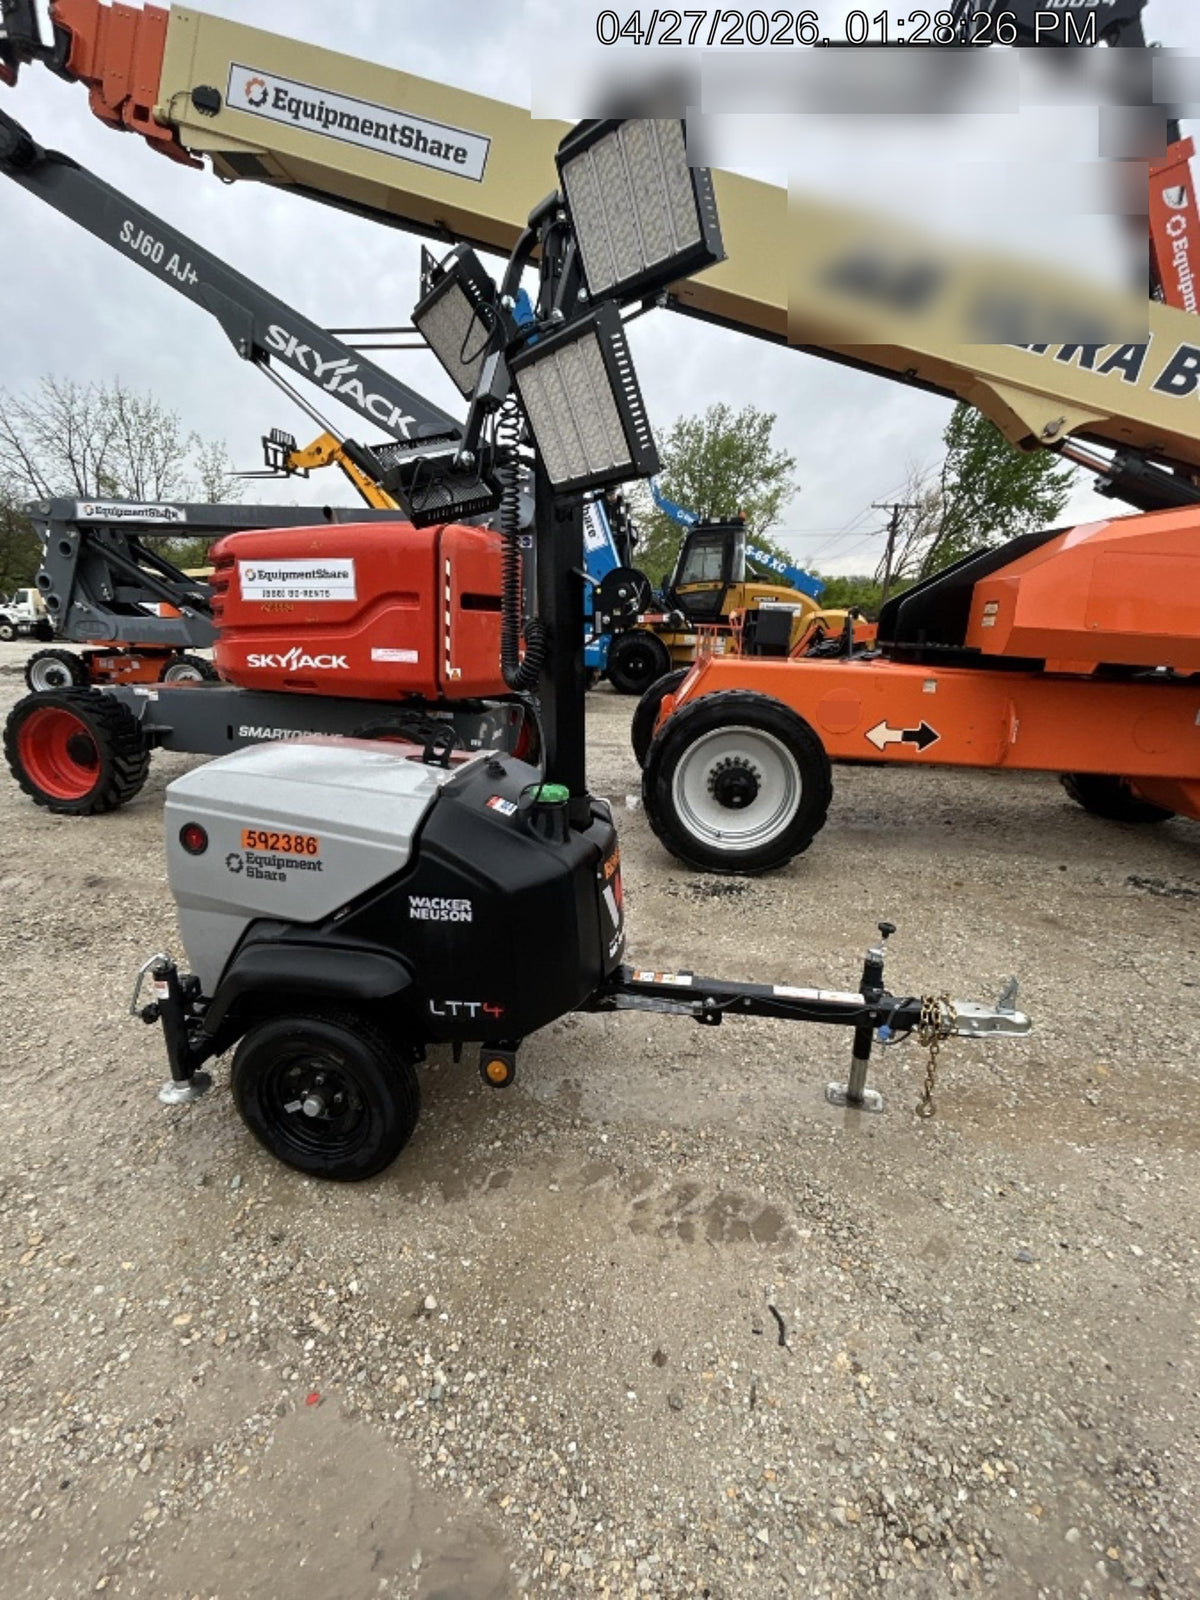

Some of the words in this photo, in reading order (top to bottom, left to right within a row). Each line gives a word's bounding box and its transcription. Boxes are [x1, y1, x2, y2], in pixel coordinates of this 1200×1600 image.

[271, 88, 469, 165] EquipmentShare
[119, 220, 165, 266] SJ60
[165, 256, 200, 287] AJ+
[263, 323, 417, 440] SKYJACK
[256, 567, 350, 582] EquipmentShare
[246, 646, 351, 672] SKYJACK
[246, 829, 318, 855] 592386
[244, 851, 324, 872] Equipment
[245, 865, 288, 883] Share
[408, 895, 472, 912] WACKER
[409, 907, 473, 922] NEUSON
[428, 999, 504, 1019] LTT4
